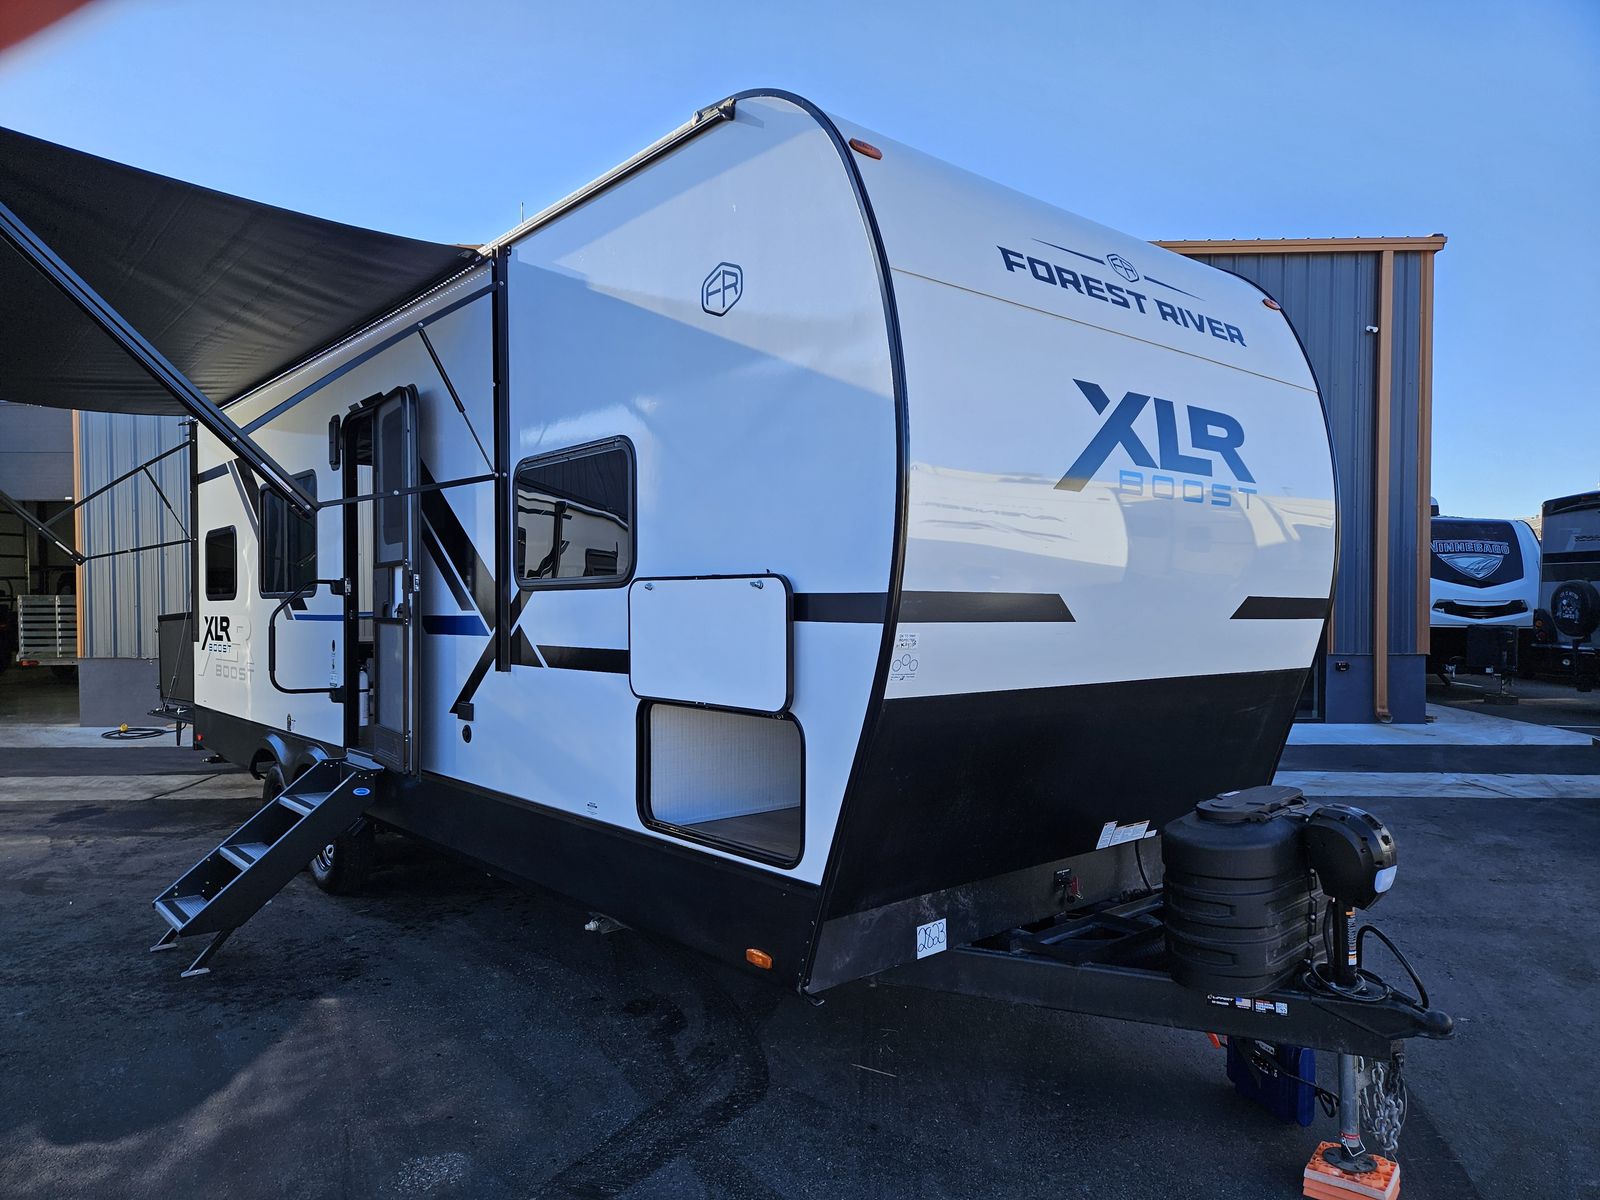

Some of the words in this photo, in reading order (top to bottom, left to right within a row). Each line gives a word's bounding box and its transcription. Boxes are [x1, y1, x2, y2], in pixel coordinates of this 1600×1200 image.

[996, 245, 1147, 314] FOREST
[1153, 298, 1247, 347] RIVER
[1053, 378, 1256, 492] XLR
[1119, 469, 1257, 509] BOOST
[201, 616, 231, 650] XLR
[208, 643, 232, 653] BOOST
[215, 663, 254, 681] BOOST
[918, 922, 945, 952] 2823
